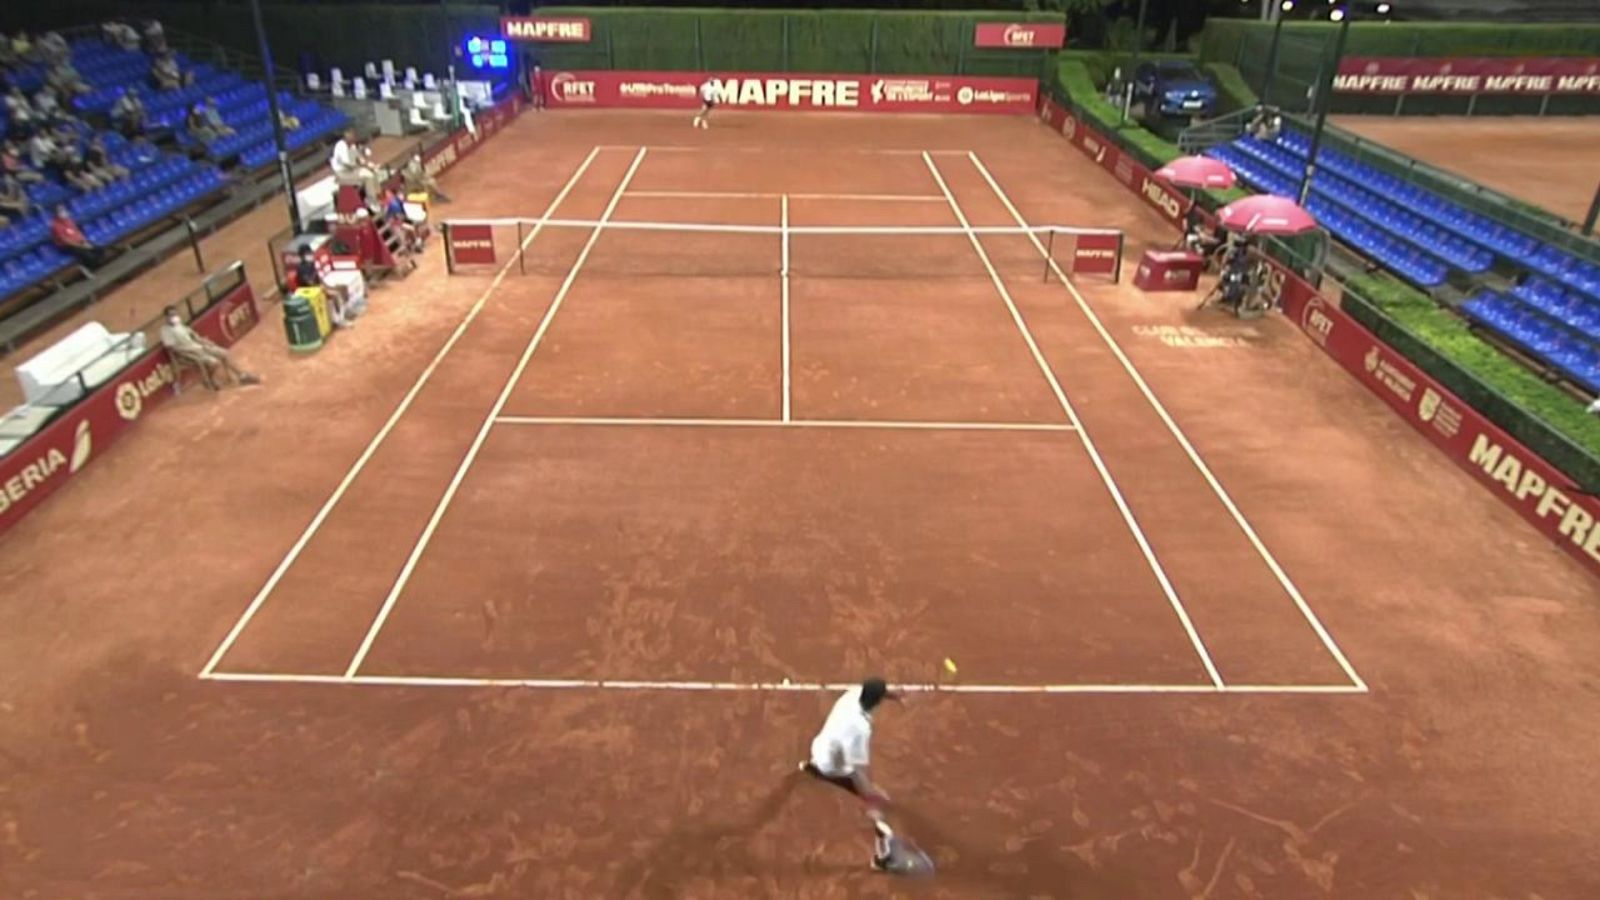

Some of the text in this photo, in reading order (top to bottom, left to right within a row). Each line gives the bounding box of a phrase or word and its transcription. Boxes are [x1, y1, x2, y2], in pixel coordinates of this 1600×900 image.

[507, 22, 584, 38] MAPFRE
[1332, 75, 1407, 90] MAPFRE
[1411, 75, 1481, 90] MAPFRE
[1484, 75, 1554, 90] MAPFRE
[710, 79, 859, 106] MAPFRE
[1142, 177, 1180, 218] HEAD
[1468, 433, 1600, 563] MAPFRE
